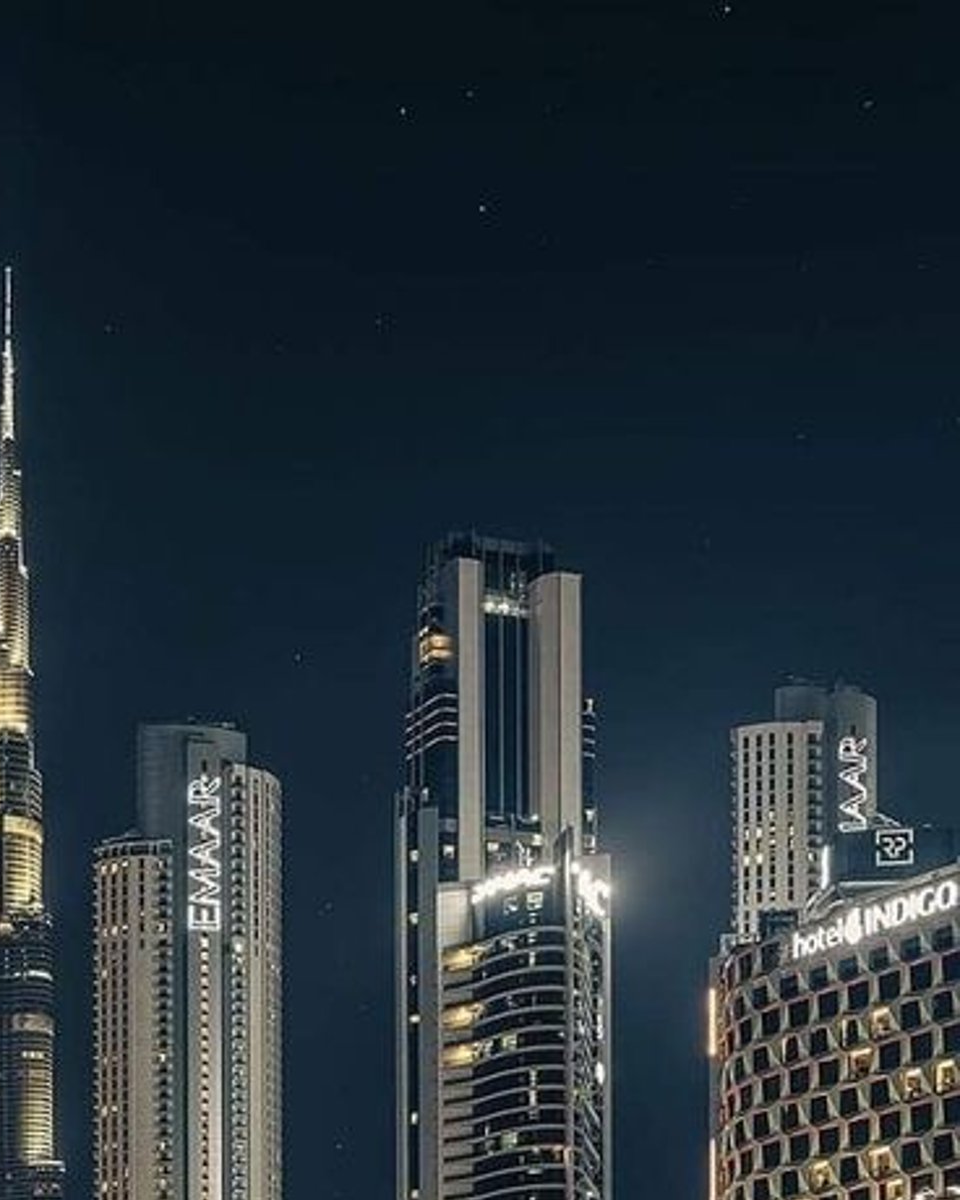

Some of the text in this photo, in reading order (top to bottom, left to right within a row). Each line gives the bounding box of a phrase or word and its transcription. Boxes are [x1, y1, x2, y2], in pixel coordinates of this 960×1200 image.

[188, 775, 221, 931] EMAAR
[792, 880, 958, 959] hotel INDIGO
